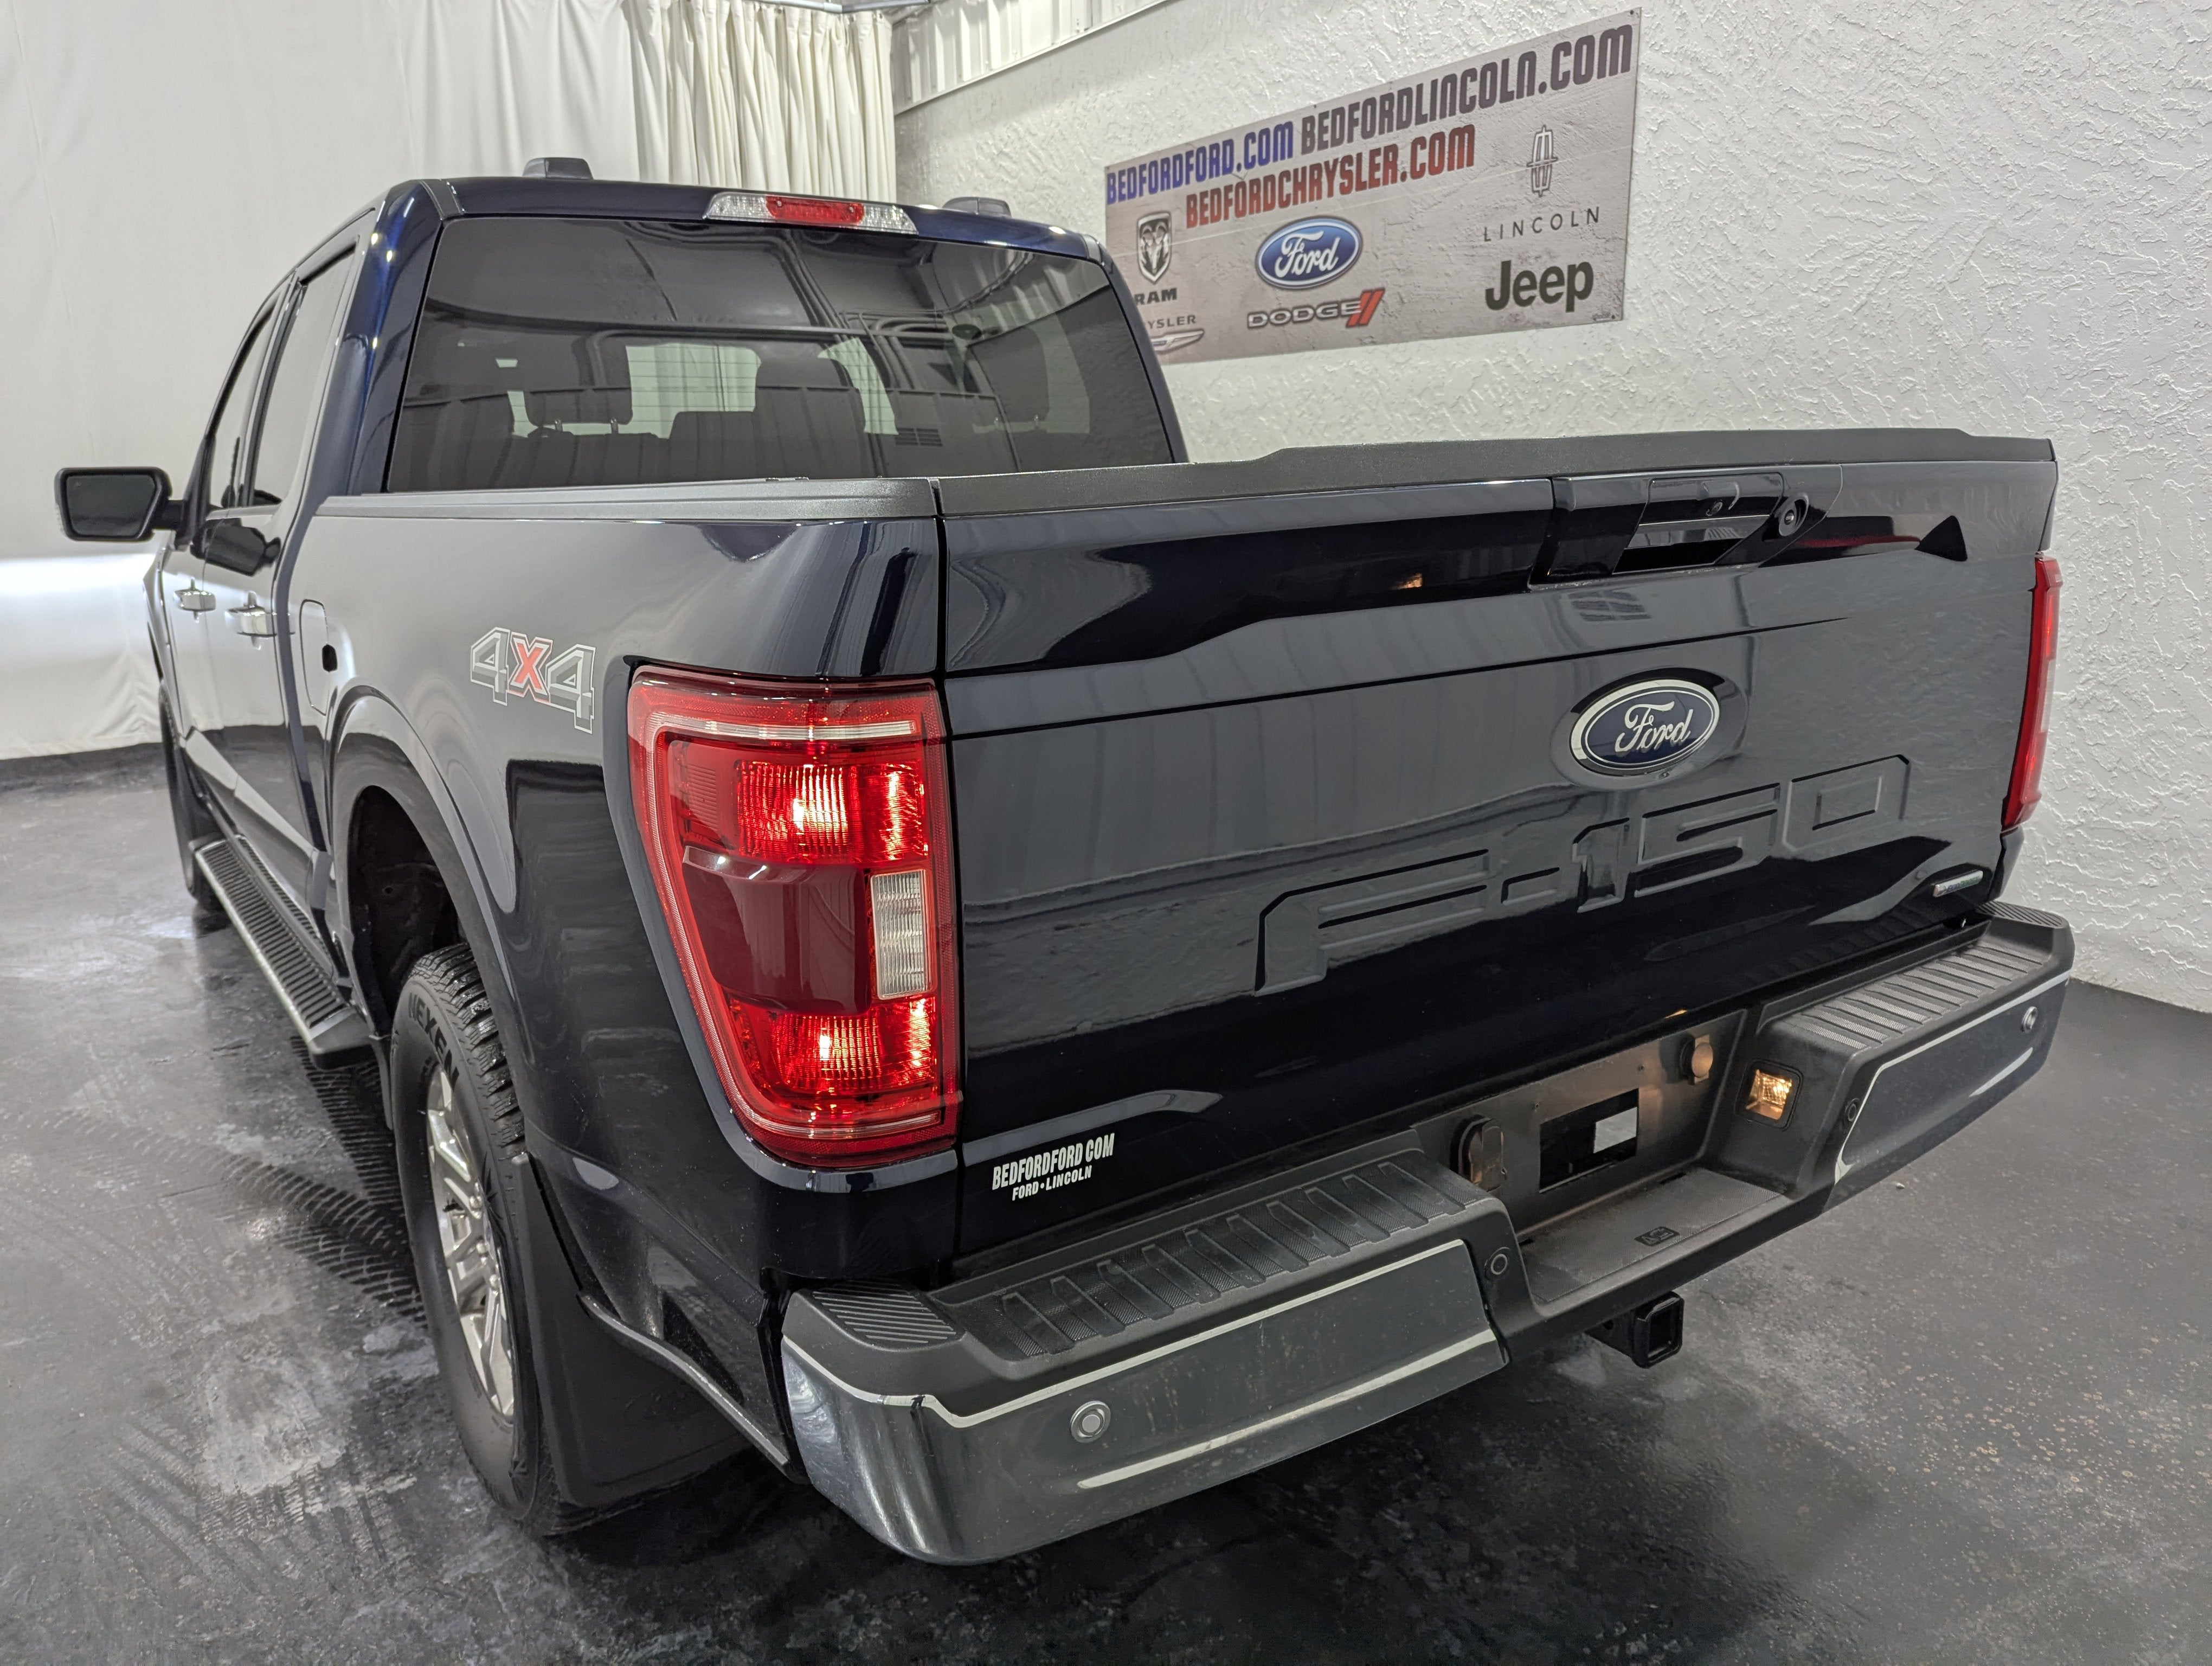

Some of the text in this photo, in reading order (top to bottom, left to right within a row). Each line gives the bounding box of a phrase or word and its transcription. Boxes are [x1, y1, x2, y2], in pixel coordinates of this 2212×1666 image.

[1107, 24, 1633, 205] BEDFORDFORD.COM BEDFORDLINCOLN.COM
[1186, 124, 1475, 228] BEDFORDCHRYSLER.COM
[1484, 207, 1599, 242] LINCOLN
[1275, 230, 1341, 278] Ford
[1134, 287, 1178, 305] RAM
[1486, 260, 1594, 313] Jeep
[1147, 315, 1196, 330] YSLER
[1248, 298, 1362, 329] DODGE
[1615, 701, 1694, 753] Ford
[408, 992, 459, 1091] NEXEN
